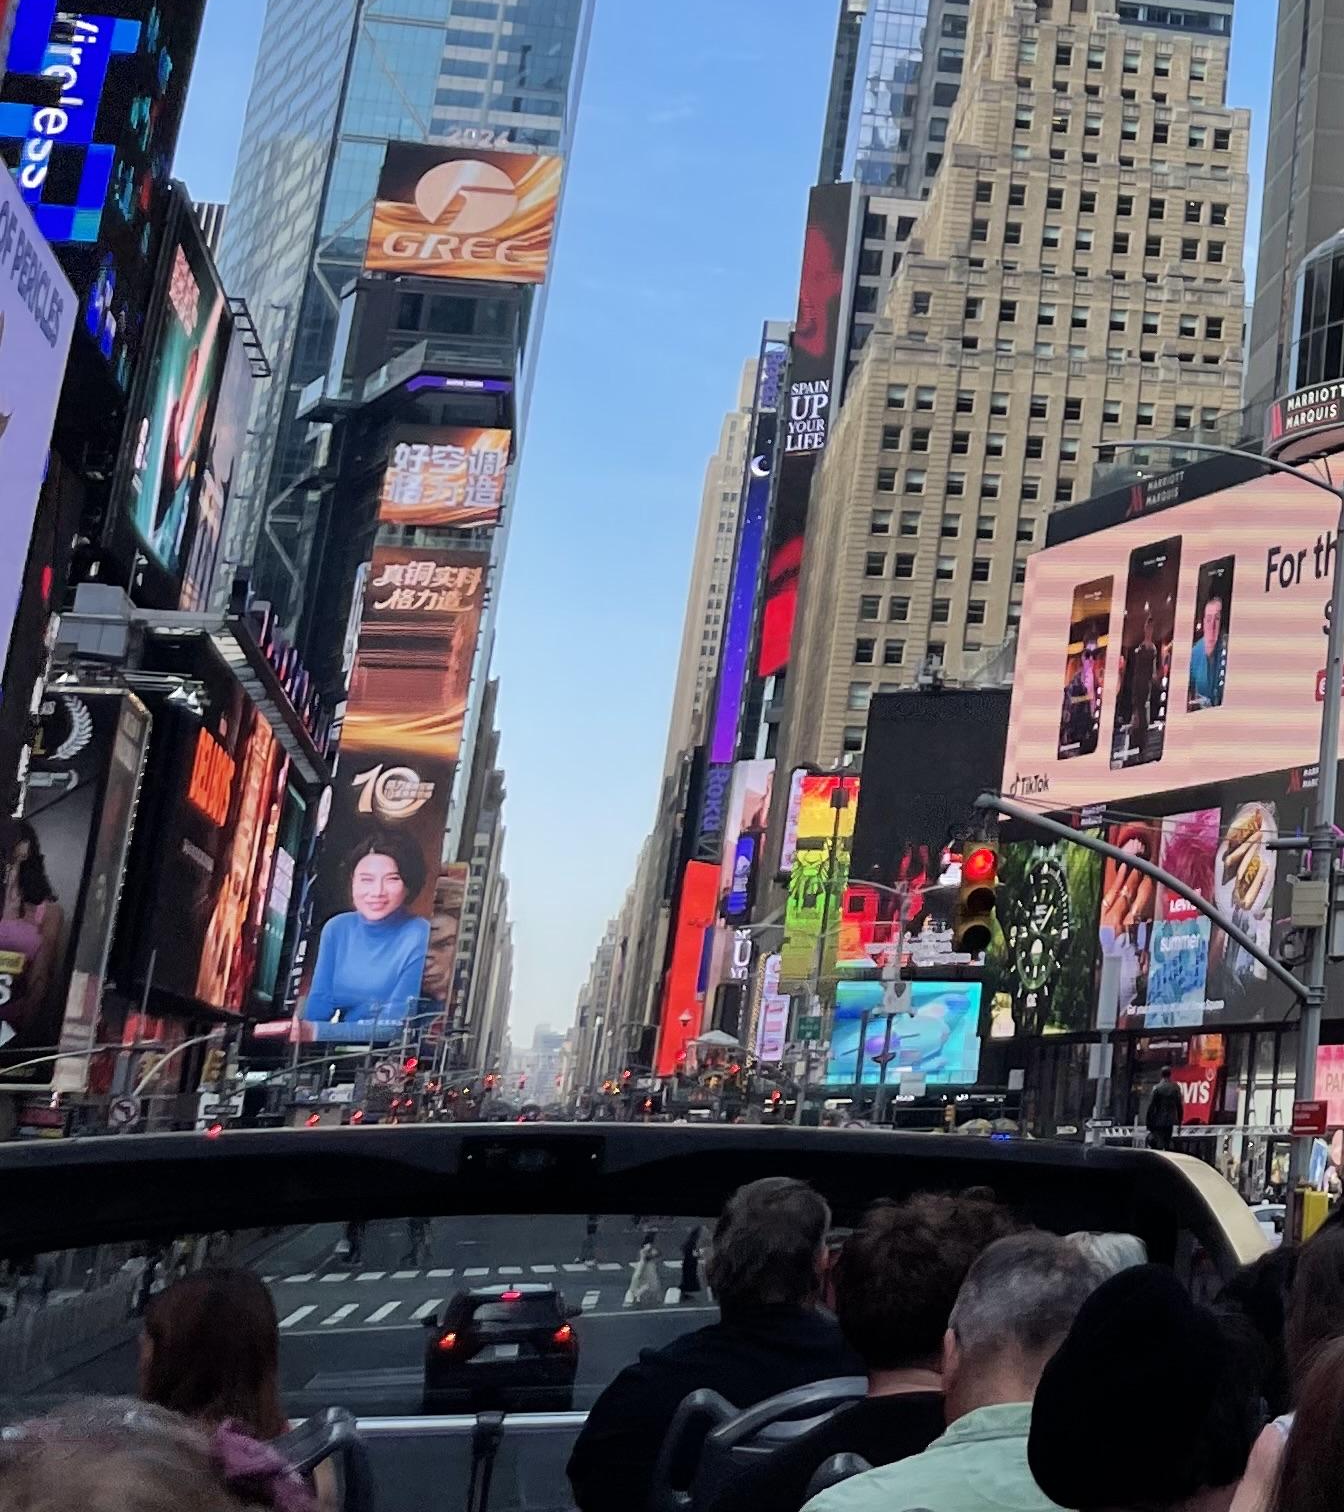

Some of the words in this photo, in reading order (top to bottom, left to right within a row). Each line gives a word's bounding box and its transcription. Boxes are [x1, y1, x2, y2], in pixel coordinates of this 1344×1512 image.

[791, 379, 831, 396] SPAIN
[790, 393, 829, 421] UP
[1285, 403, 1339, 430] MARQUIS
[787, 419, 826, 434] YOUR
[785, 432, 826, 452] LIFE
[1264, 545, 1306, 594] For
